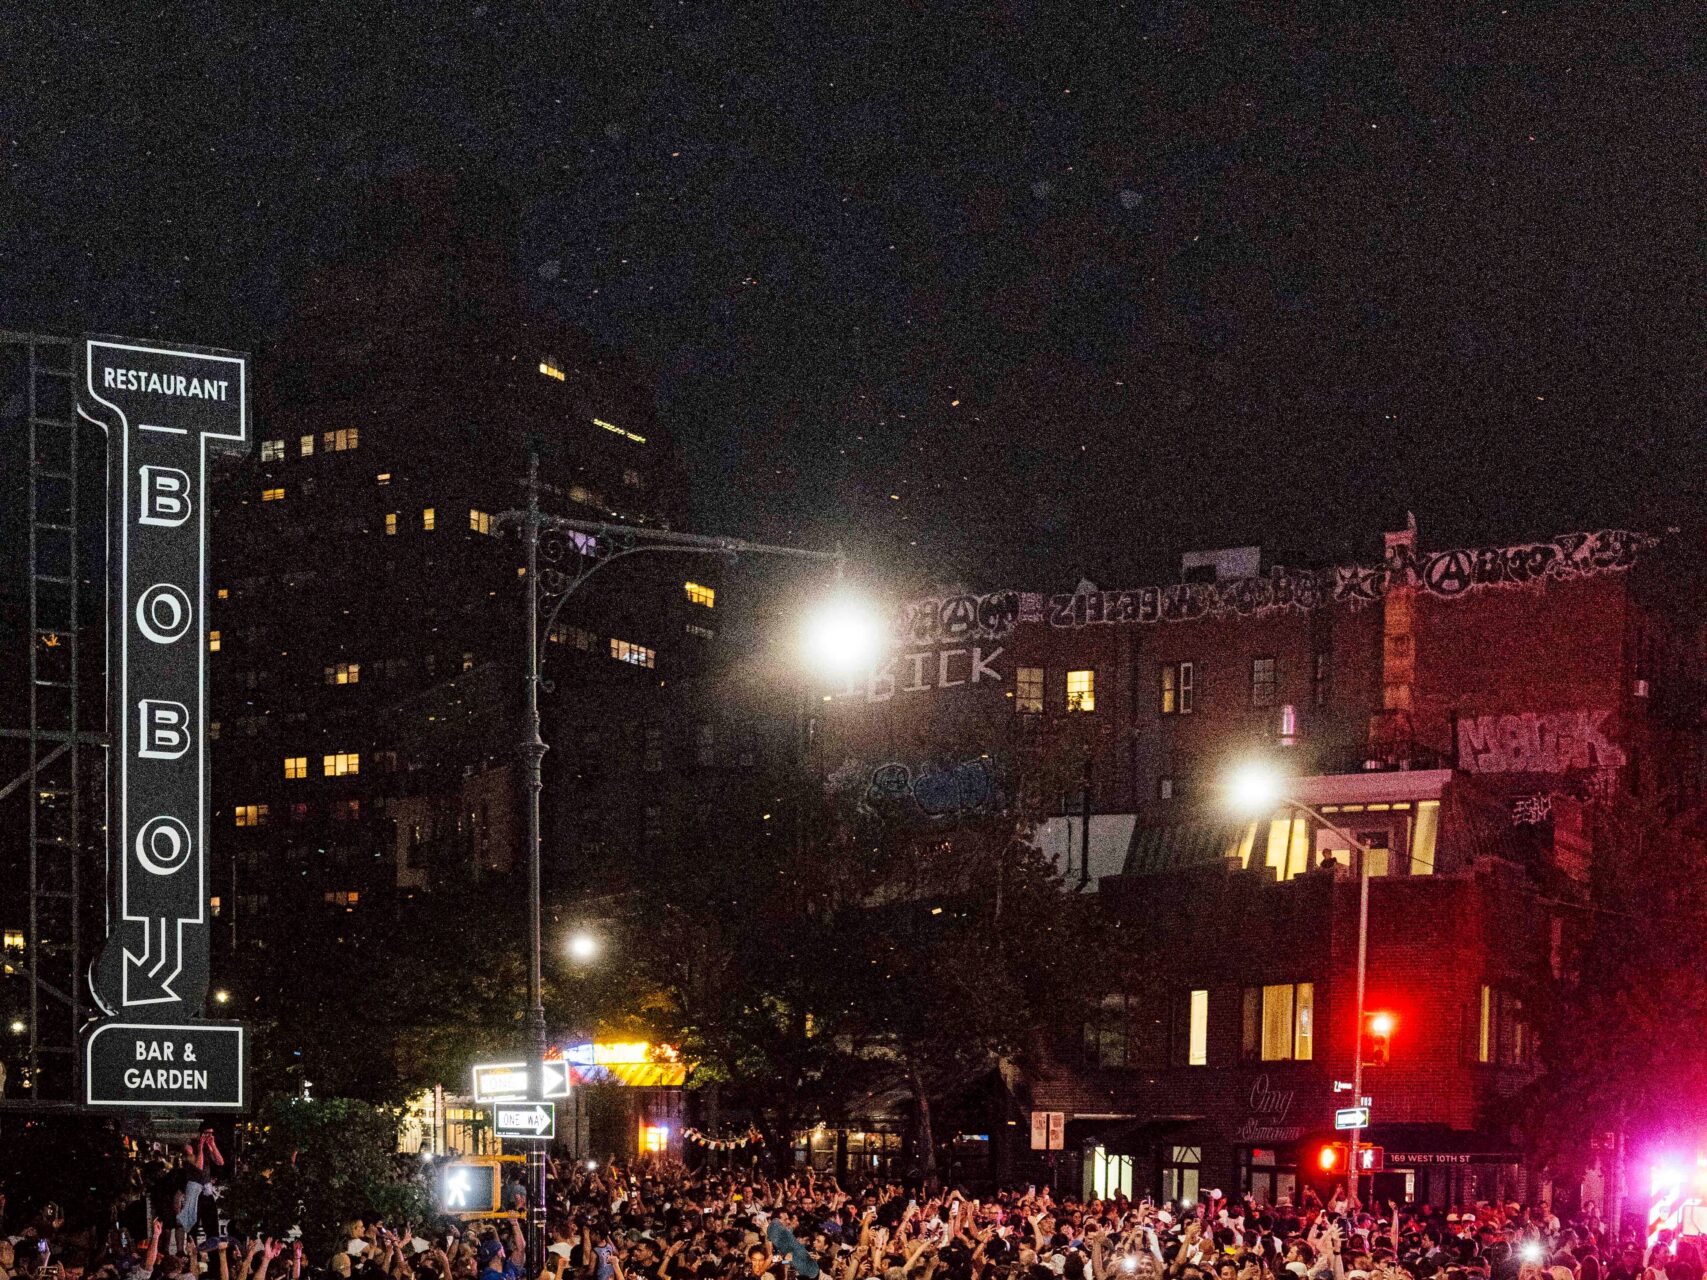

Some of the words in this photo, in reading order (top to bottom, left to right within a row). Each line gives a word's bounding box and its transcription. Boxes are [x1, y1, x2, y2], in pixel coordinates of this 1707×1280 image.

[104, 366, 229, 401] RESTAURANT
[135, 464, 193, 876] BOBO
[135, 1040, 174, 1062] BAR
[183, 1041, 197, 1062] &
[123, 1068, 209, 1091] GARDEN
[503, 1112, 521, 1126] ONE
[527, 1113, 545, 1127] WAY
[1390, 1154, 1406, 1162] 169
[1407, 1154, 1434, 1162] WEST
[1435, 1155, 1458, 1163] 10TH
[1459, 1155, 1471, 1163] ST
